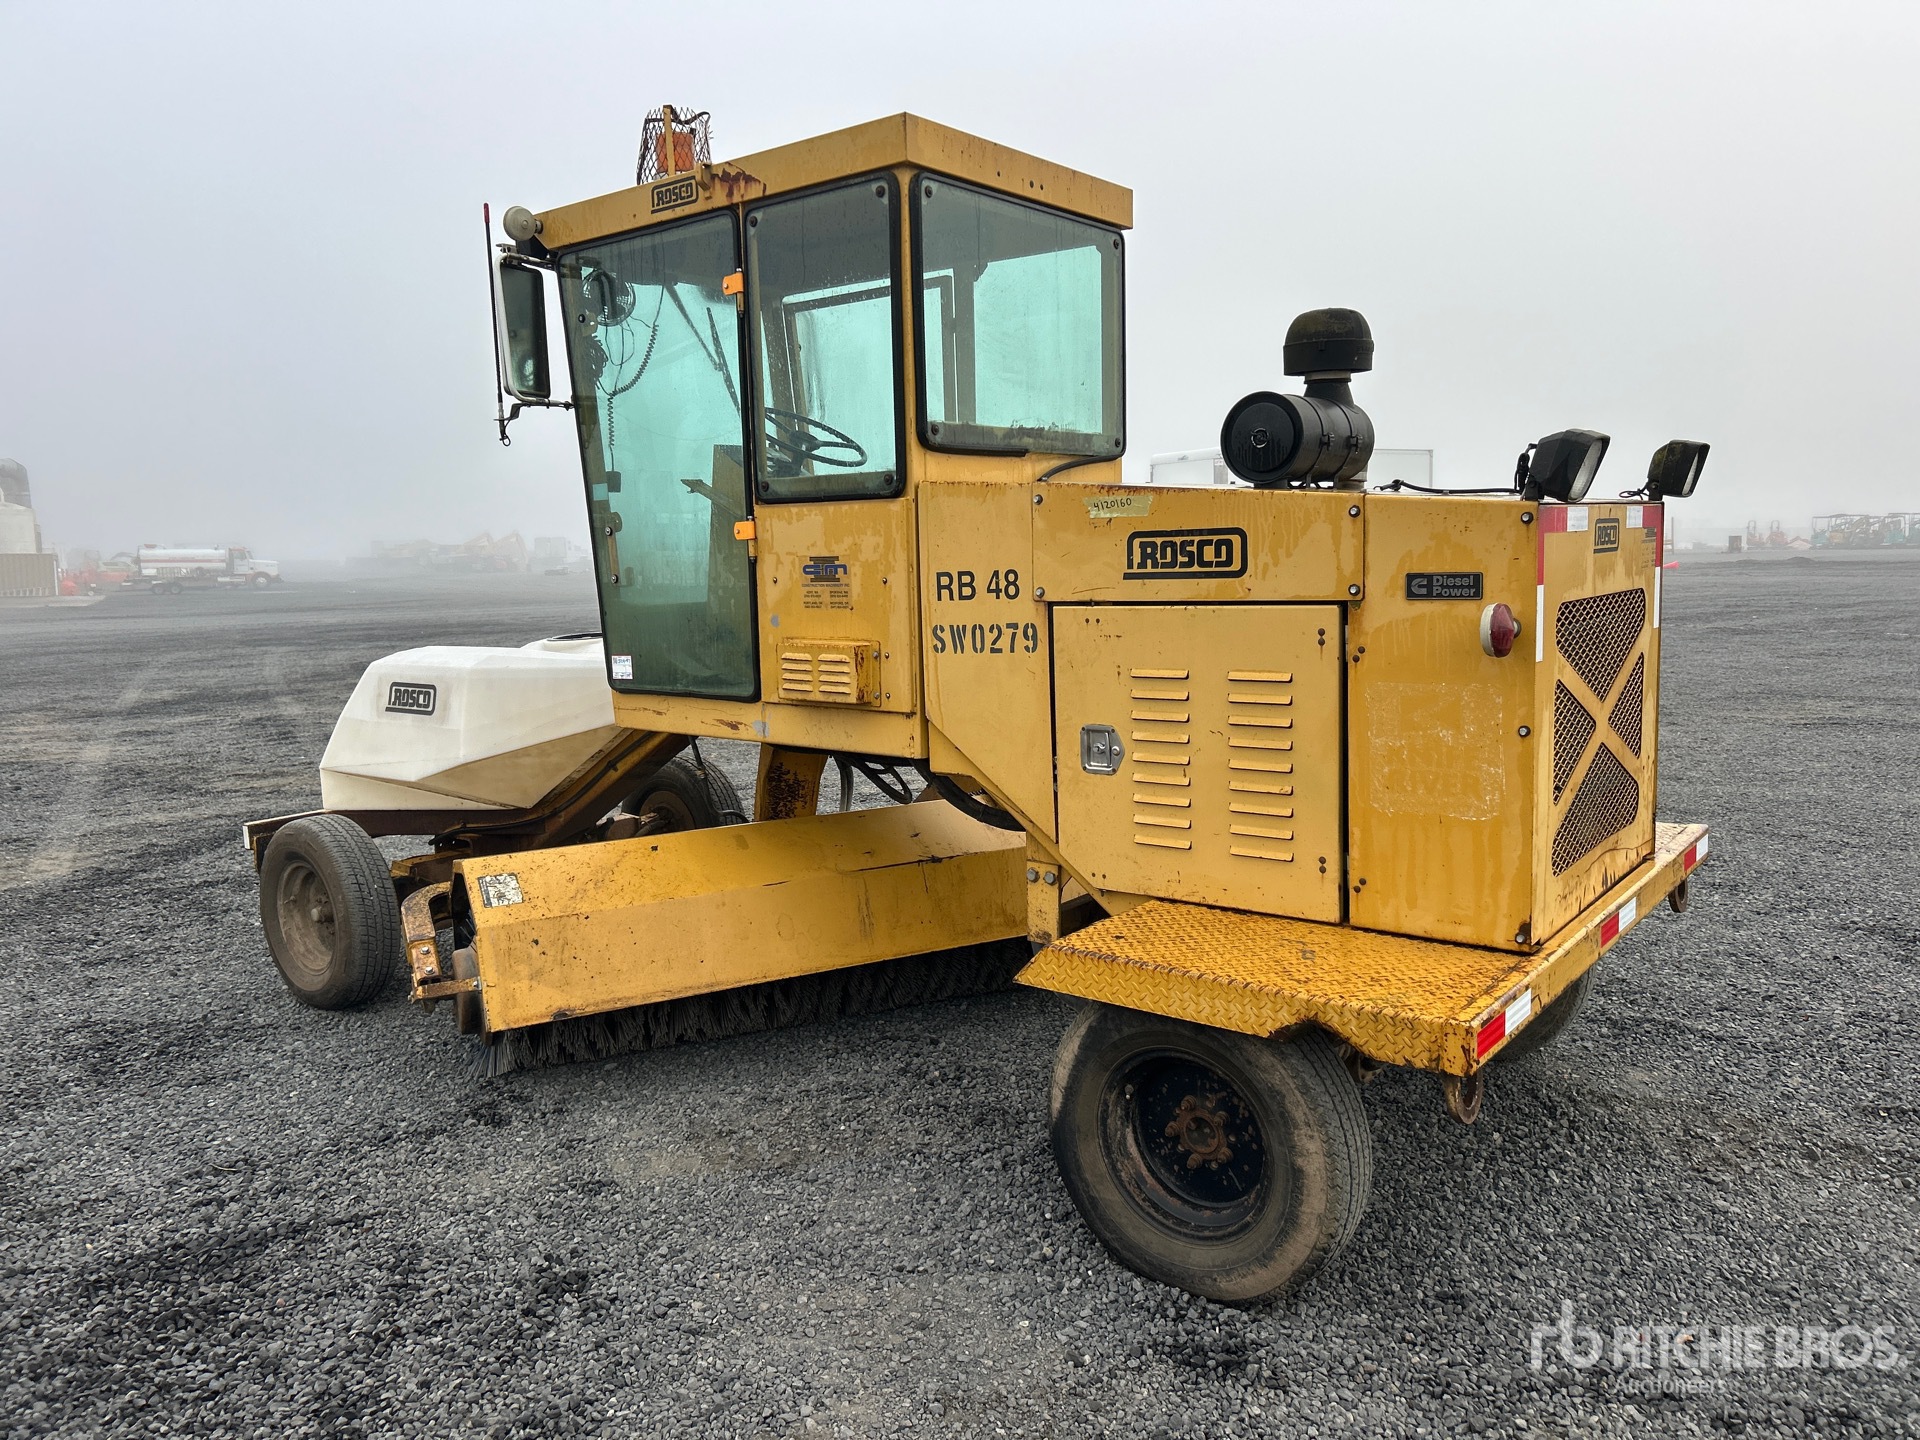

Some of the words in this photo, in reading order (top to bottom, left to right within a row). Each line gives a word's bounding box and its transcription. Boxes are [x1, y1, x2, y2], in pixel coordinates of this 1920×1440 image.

[656, 182, 693, 207] ROSCO
[1094, 497, 1132, 512] 4120160
[1136, 538, 1234, 570] ROSCO
[936, 570, 977, 602] RB
[986, 568, 1020, 600] 48
[1432, 575, 1474, 586] Diesel
[1432, 586, 1476, 597] Power
[392, 688, 432, 709] ROSCO
